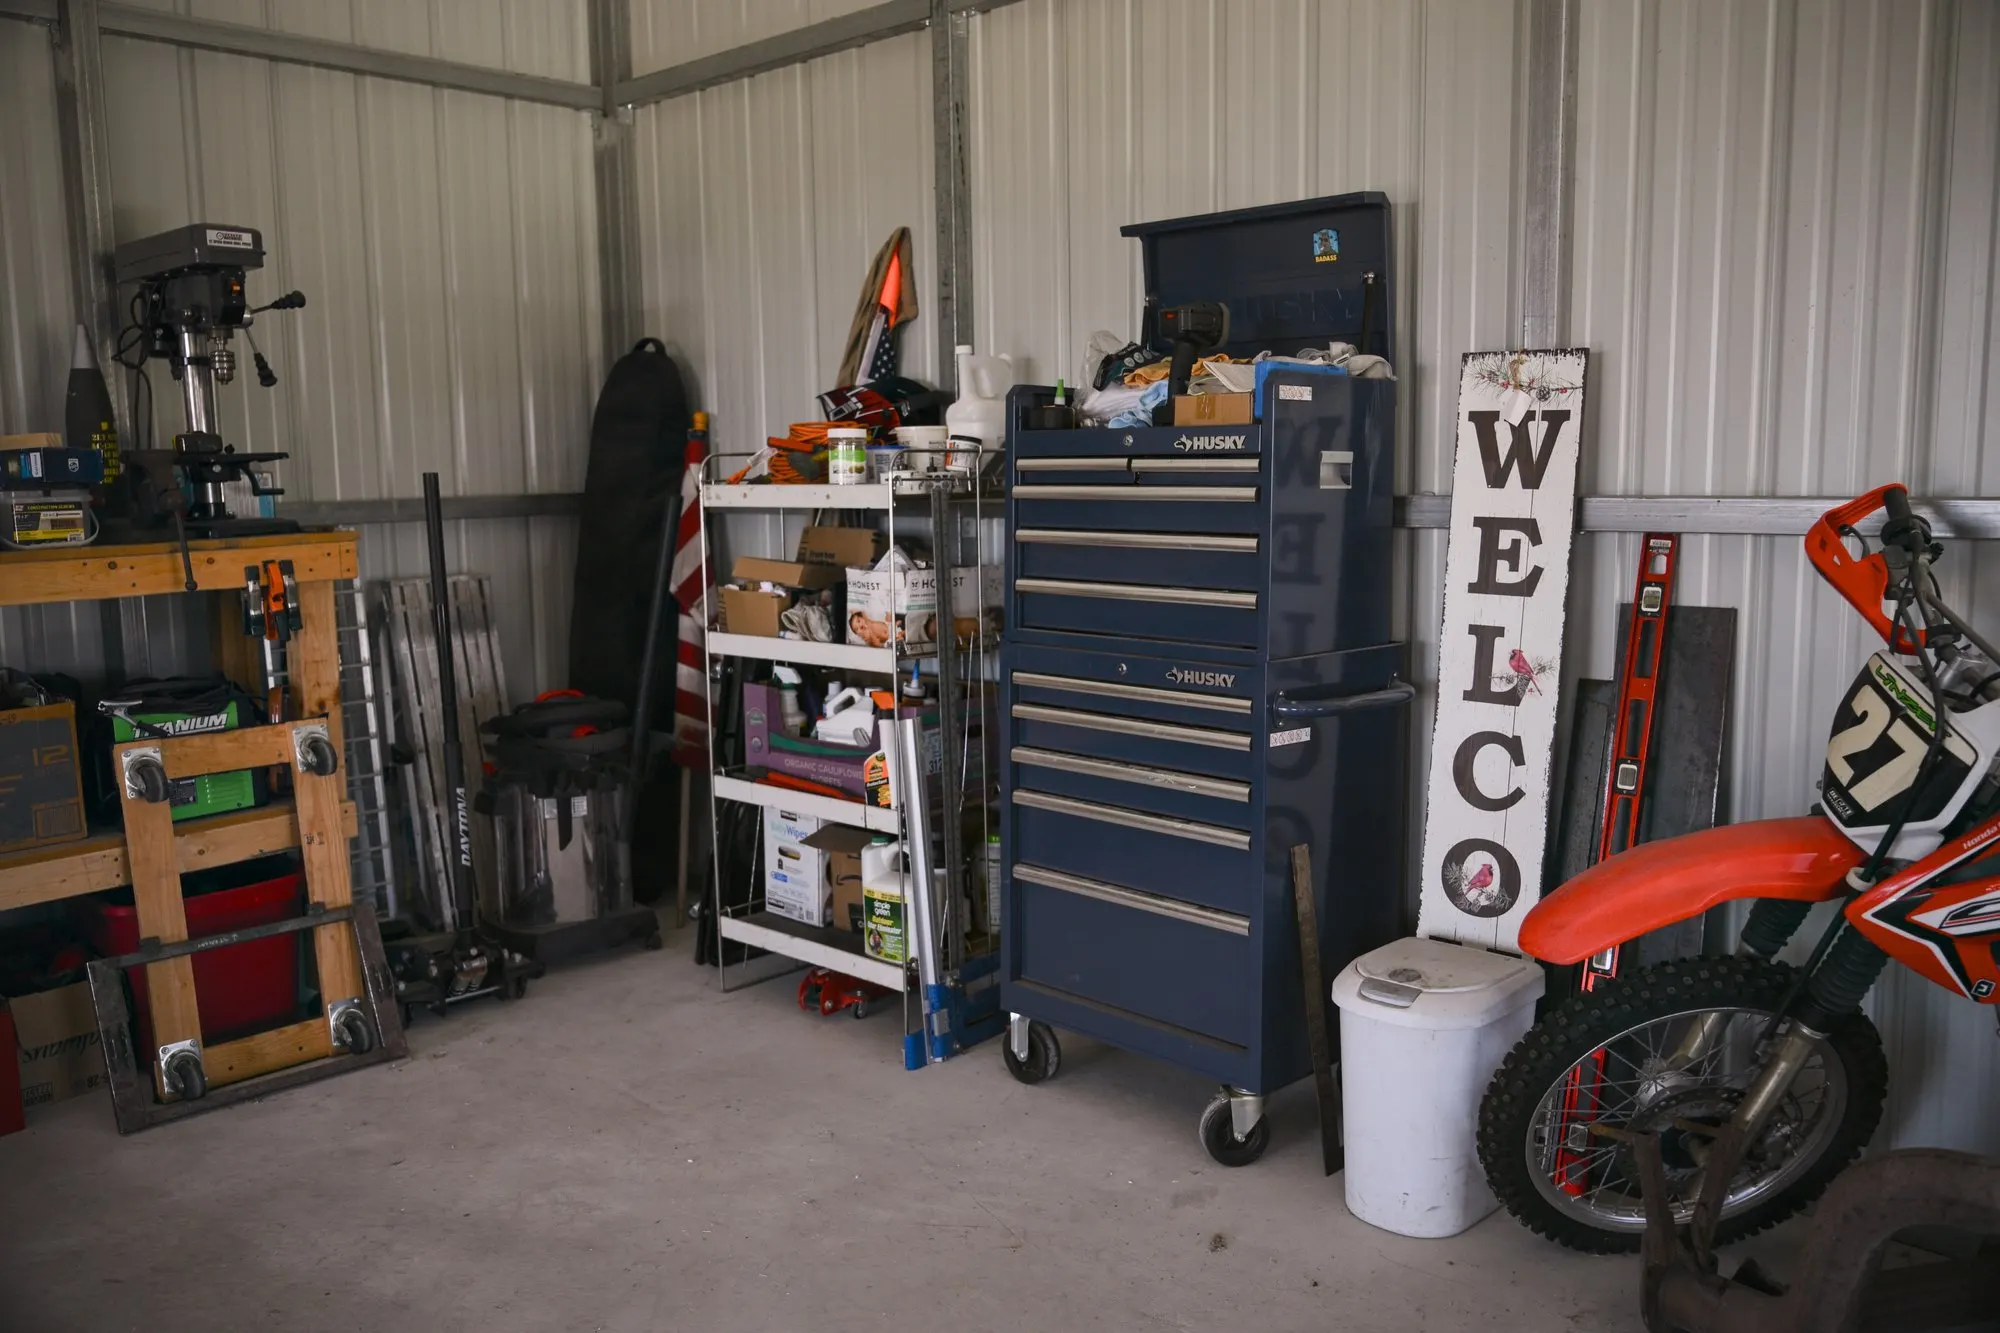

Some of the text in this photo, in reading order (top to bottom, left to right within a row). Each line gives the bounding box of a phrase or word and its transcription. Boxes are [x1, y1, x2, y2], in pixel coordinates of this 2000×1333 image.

[1315, 254, 1337, 263] BADASS
[1192, 435, 1247, 450] HUSKY
[852, 580, 881, 591] HONEST
[1183, 669, 1236, 688] HUSKY
[1429, 409, 1571, 958] WELCO
[32, 744, 70, 768] 12
[1827, 684, 1930, 813] 27
[784, 758, 817, 772] ORGANIC
[818, 765, 864, 780] CAULIFLOWE
[456, 787, 471, 867] DAYTONA
[1962, 825, 1998, 850] Honda
